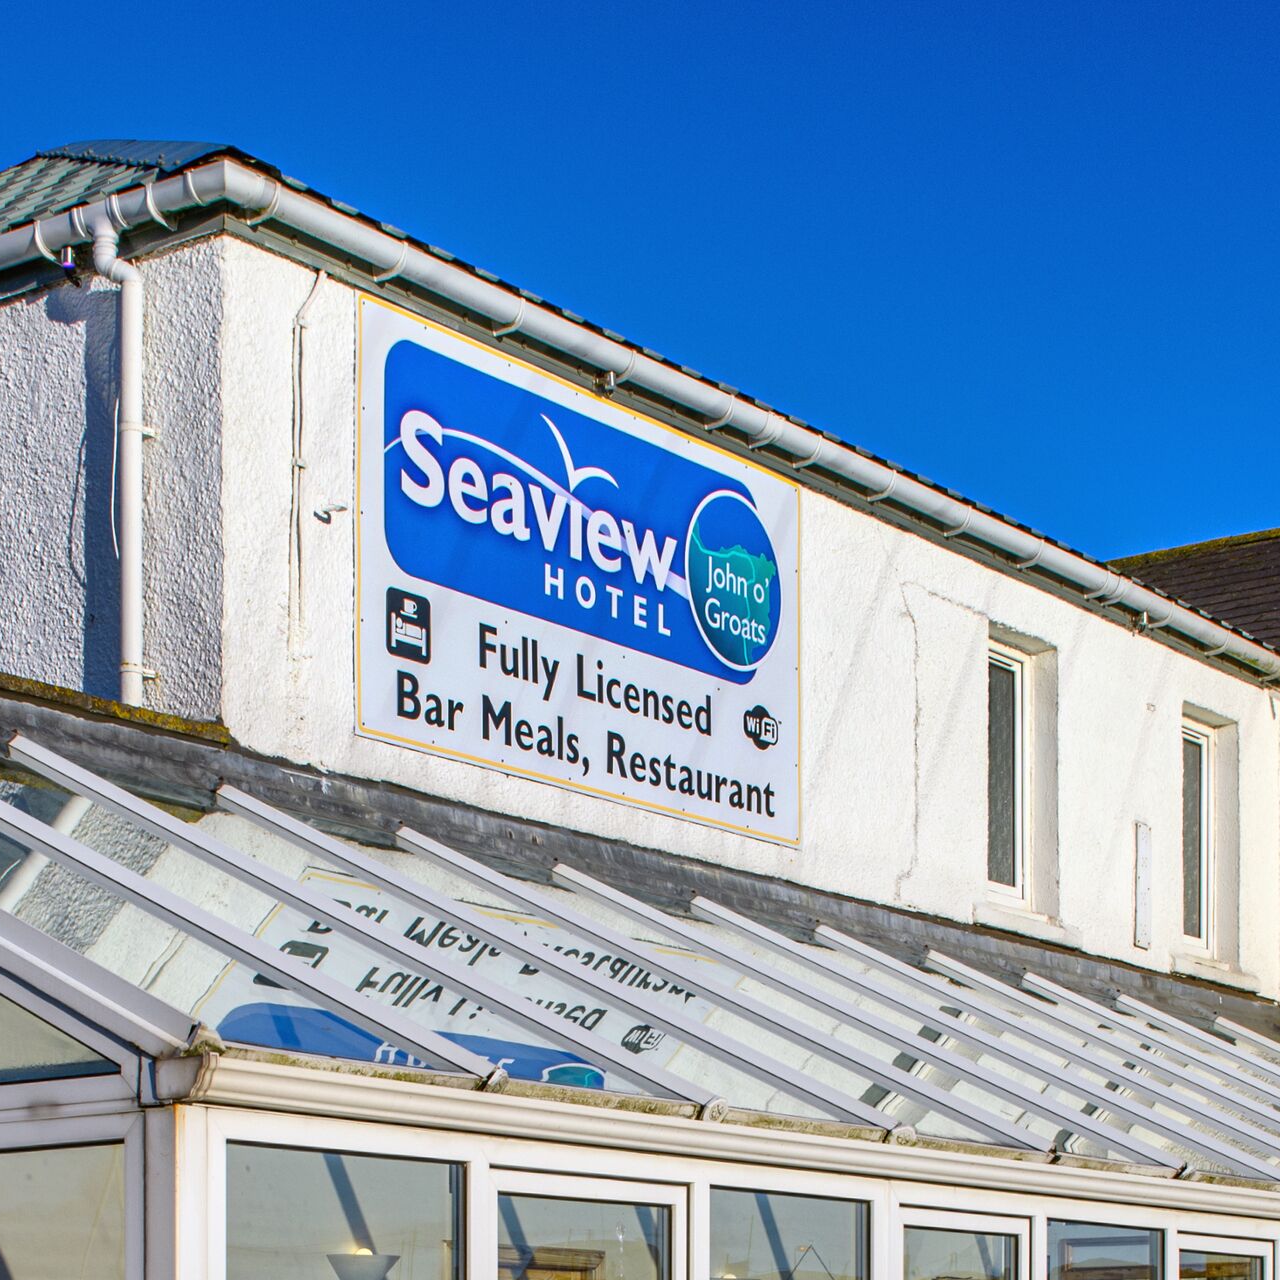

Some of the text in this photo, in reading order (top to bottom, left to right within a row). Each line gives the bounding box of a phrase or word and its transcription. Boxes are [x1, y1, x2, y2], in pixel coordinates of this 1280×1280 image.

[400, 410, 678, 591] Seaview
[544, 563, 671, 637] HOTEL
[706, 555, 748, 599] John
[704, 604, 766, 645] Groats
[479, 622, 712, 736] Fully Licensed
[396, 670, 776, 818] Bar Meals, Restaurant
